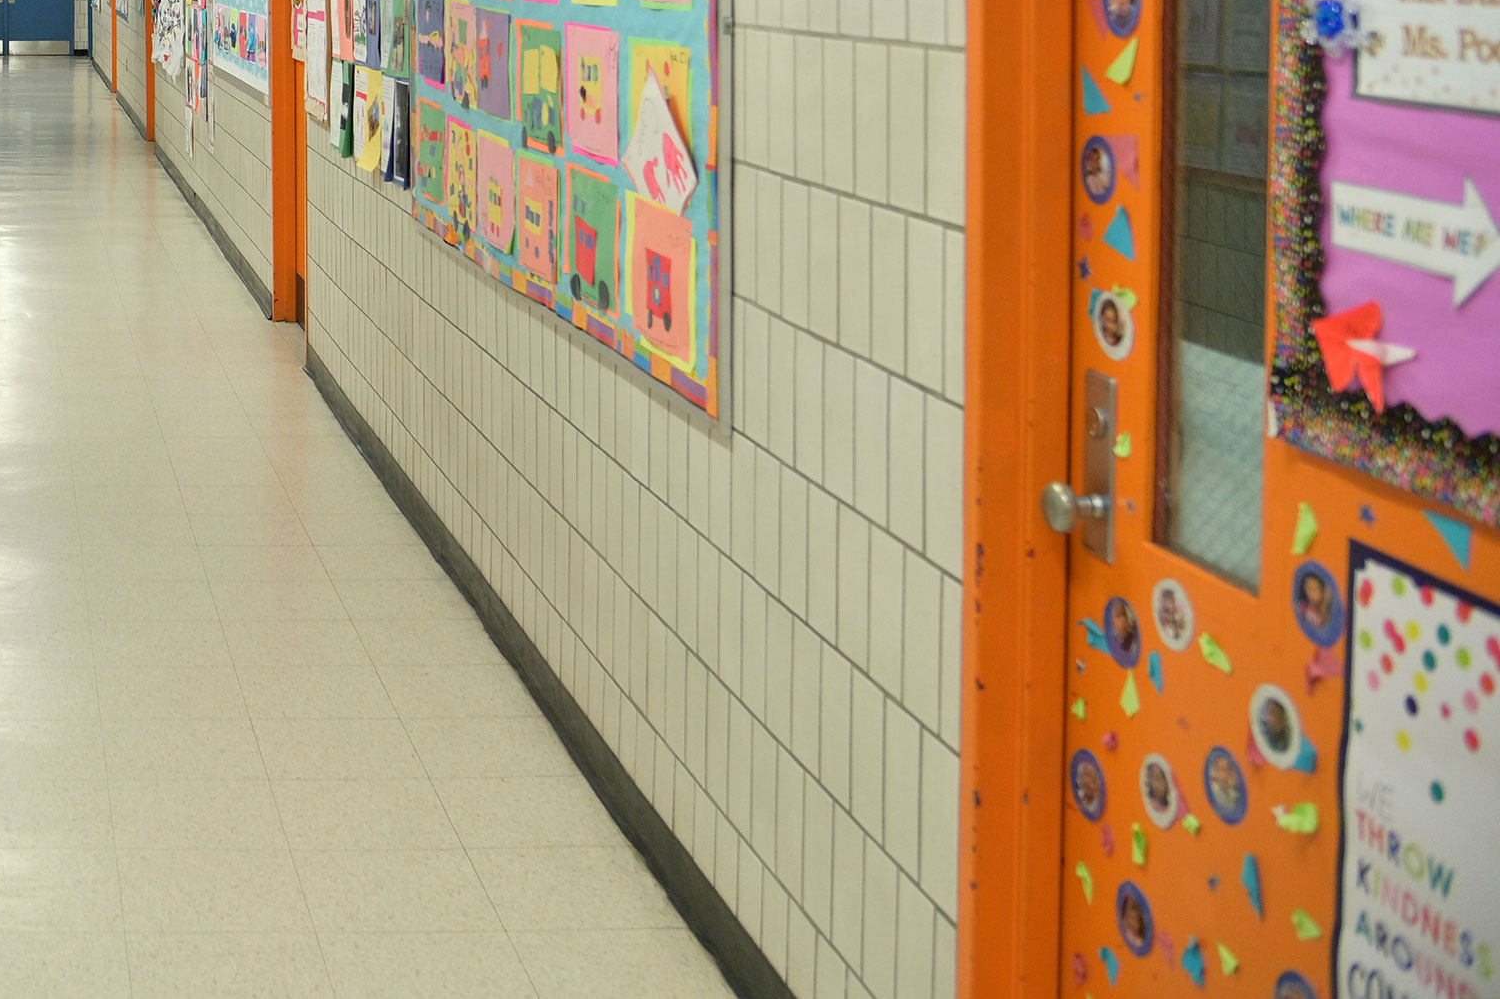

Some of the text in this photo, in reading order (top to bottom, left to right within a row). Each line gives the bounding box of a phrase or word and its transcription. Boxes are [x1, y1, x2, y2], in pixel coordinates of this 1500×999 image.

[1402, 23, 1449, 58] Ms.
[1338, 204, 1489, 258] WHERE ARE WE?
[1354, 807, 1455, 900] THROW
[1356, 857, 1494, 981] KINDNESS
[1347, 962, 1411, 999] CO
